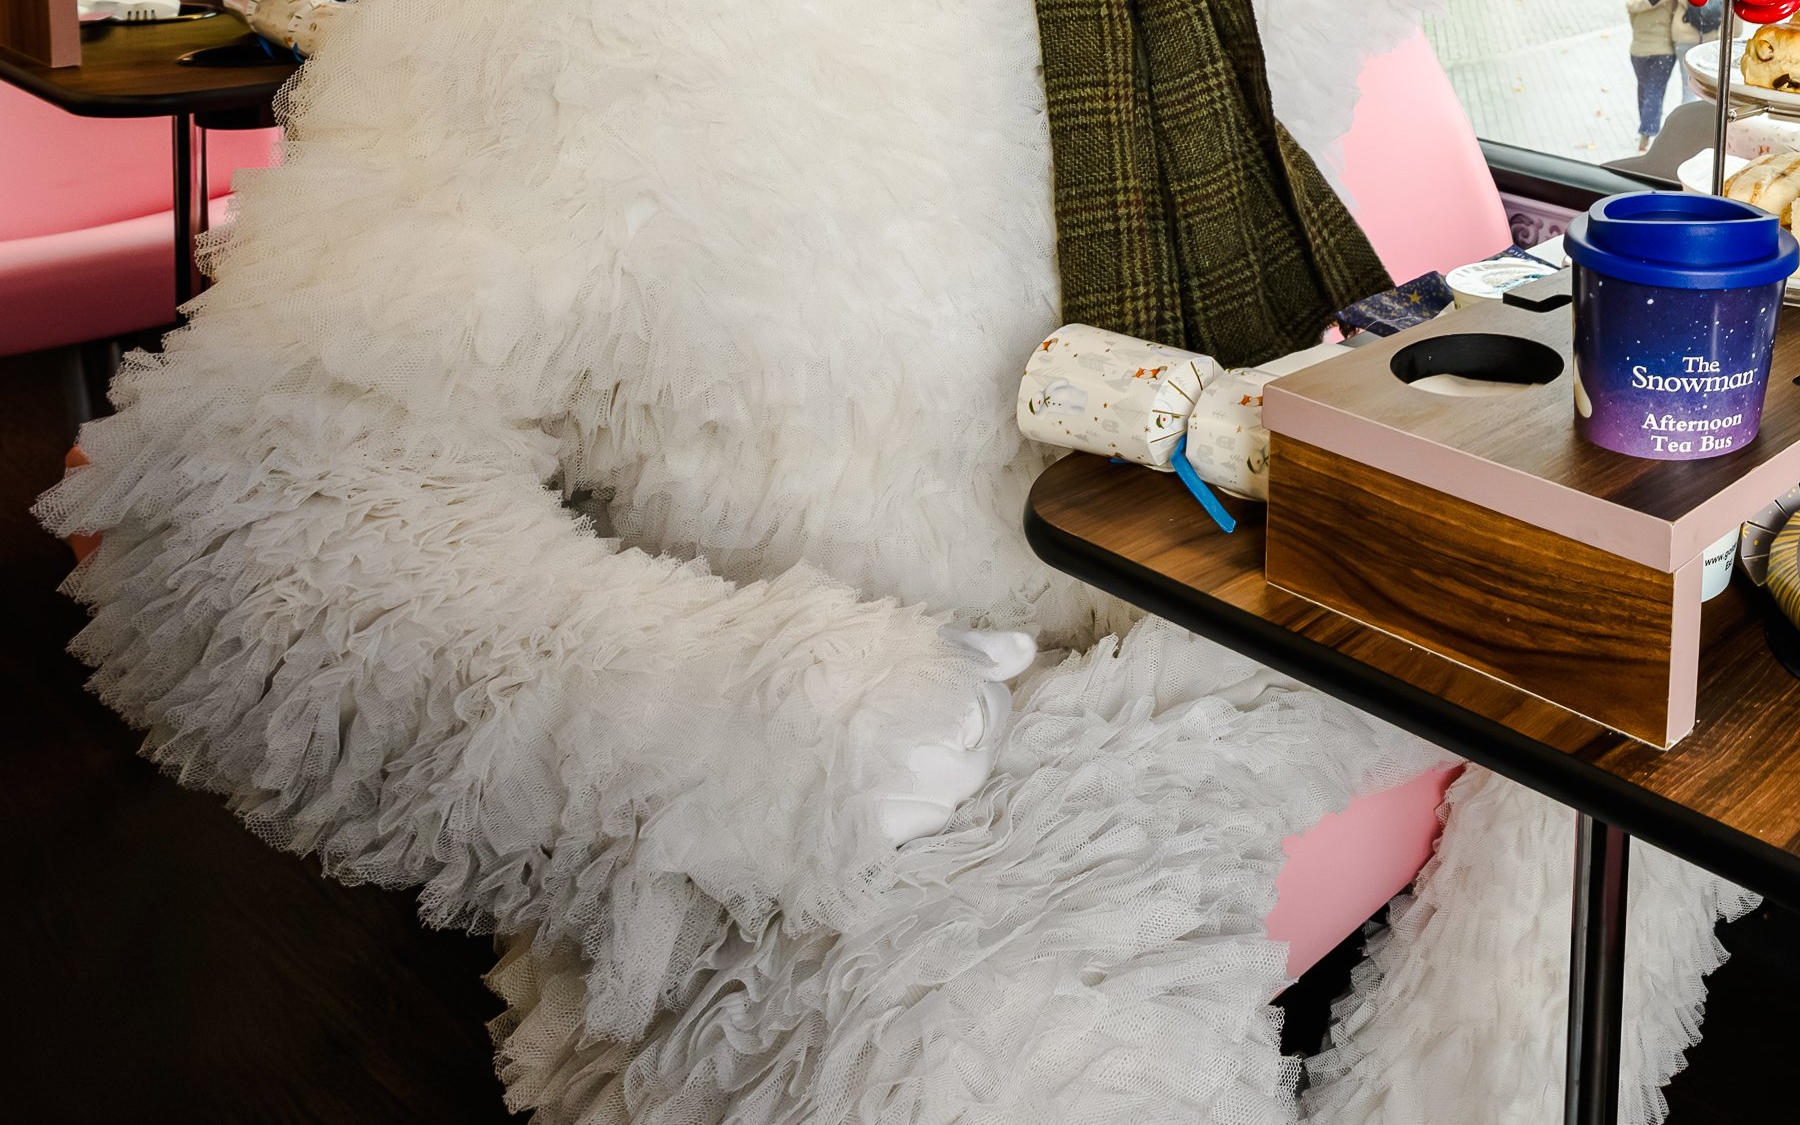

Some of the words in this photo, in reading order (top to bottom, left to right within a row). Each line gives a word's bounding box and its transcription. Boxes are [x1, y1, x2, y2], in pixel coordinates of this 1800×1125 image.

[1682, 356, 1720, 373] The
[1632, 365, 1756, 393] Snowman
[1642, 413, 1743, 431] Afternoon
[1650, 435, 1692, 453] Tea
[1699, 436, 1732, 452] Bus
